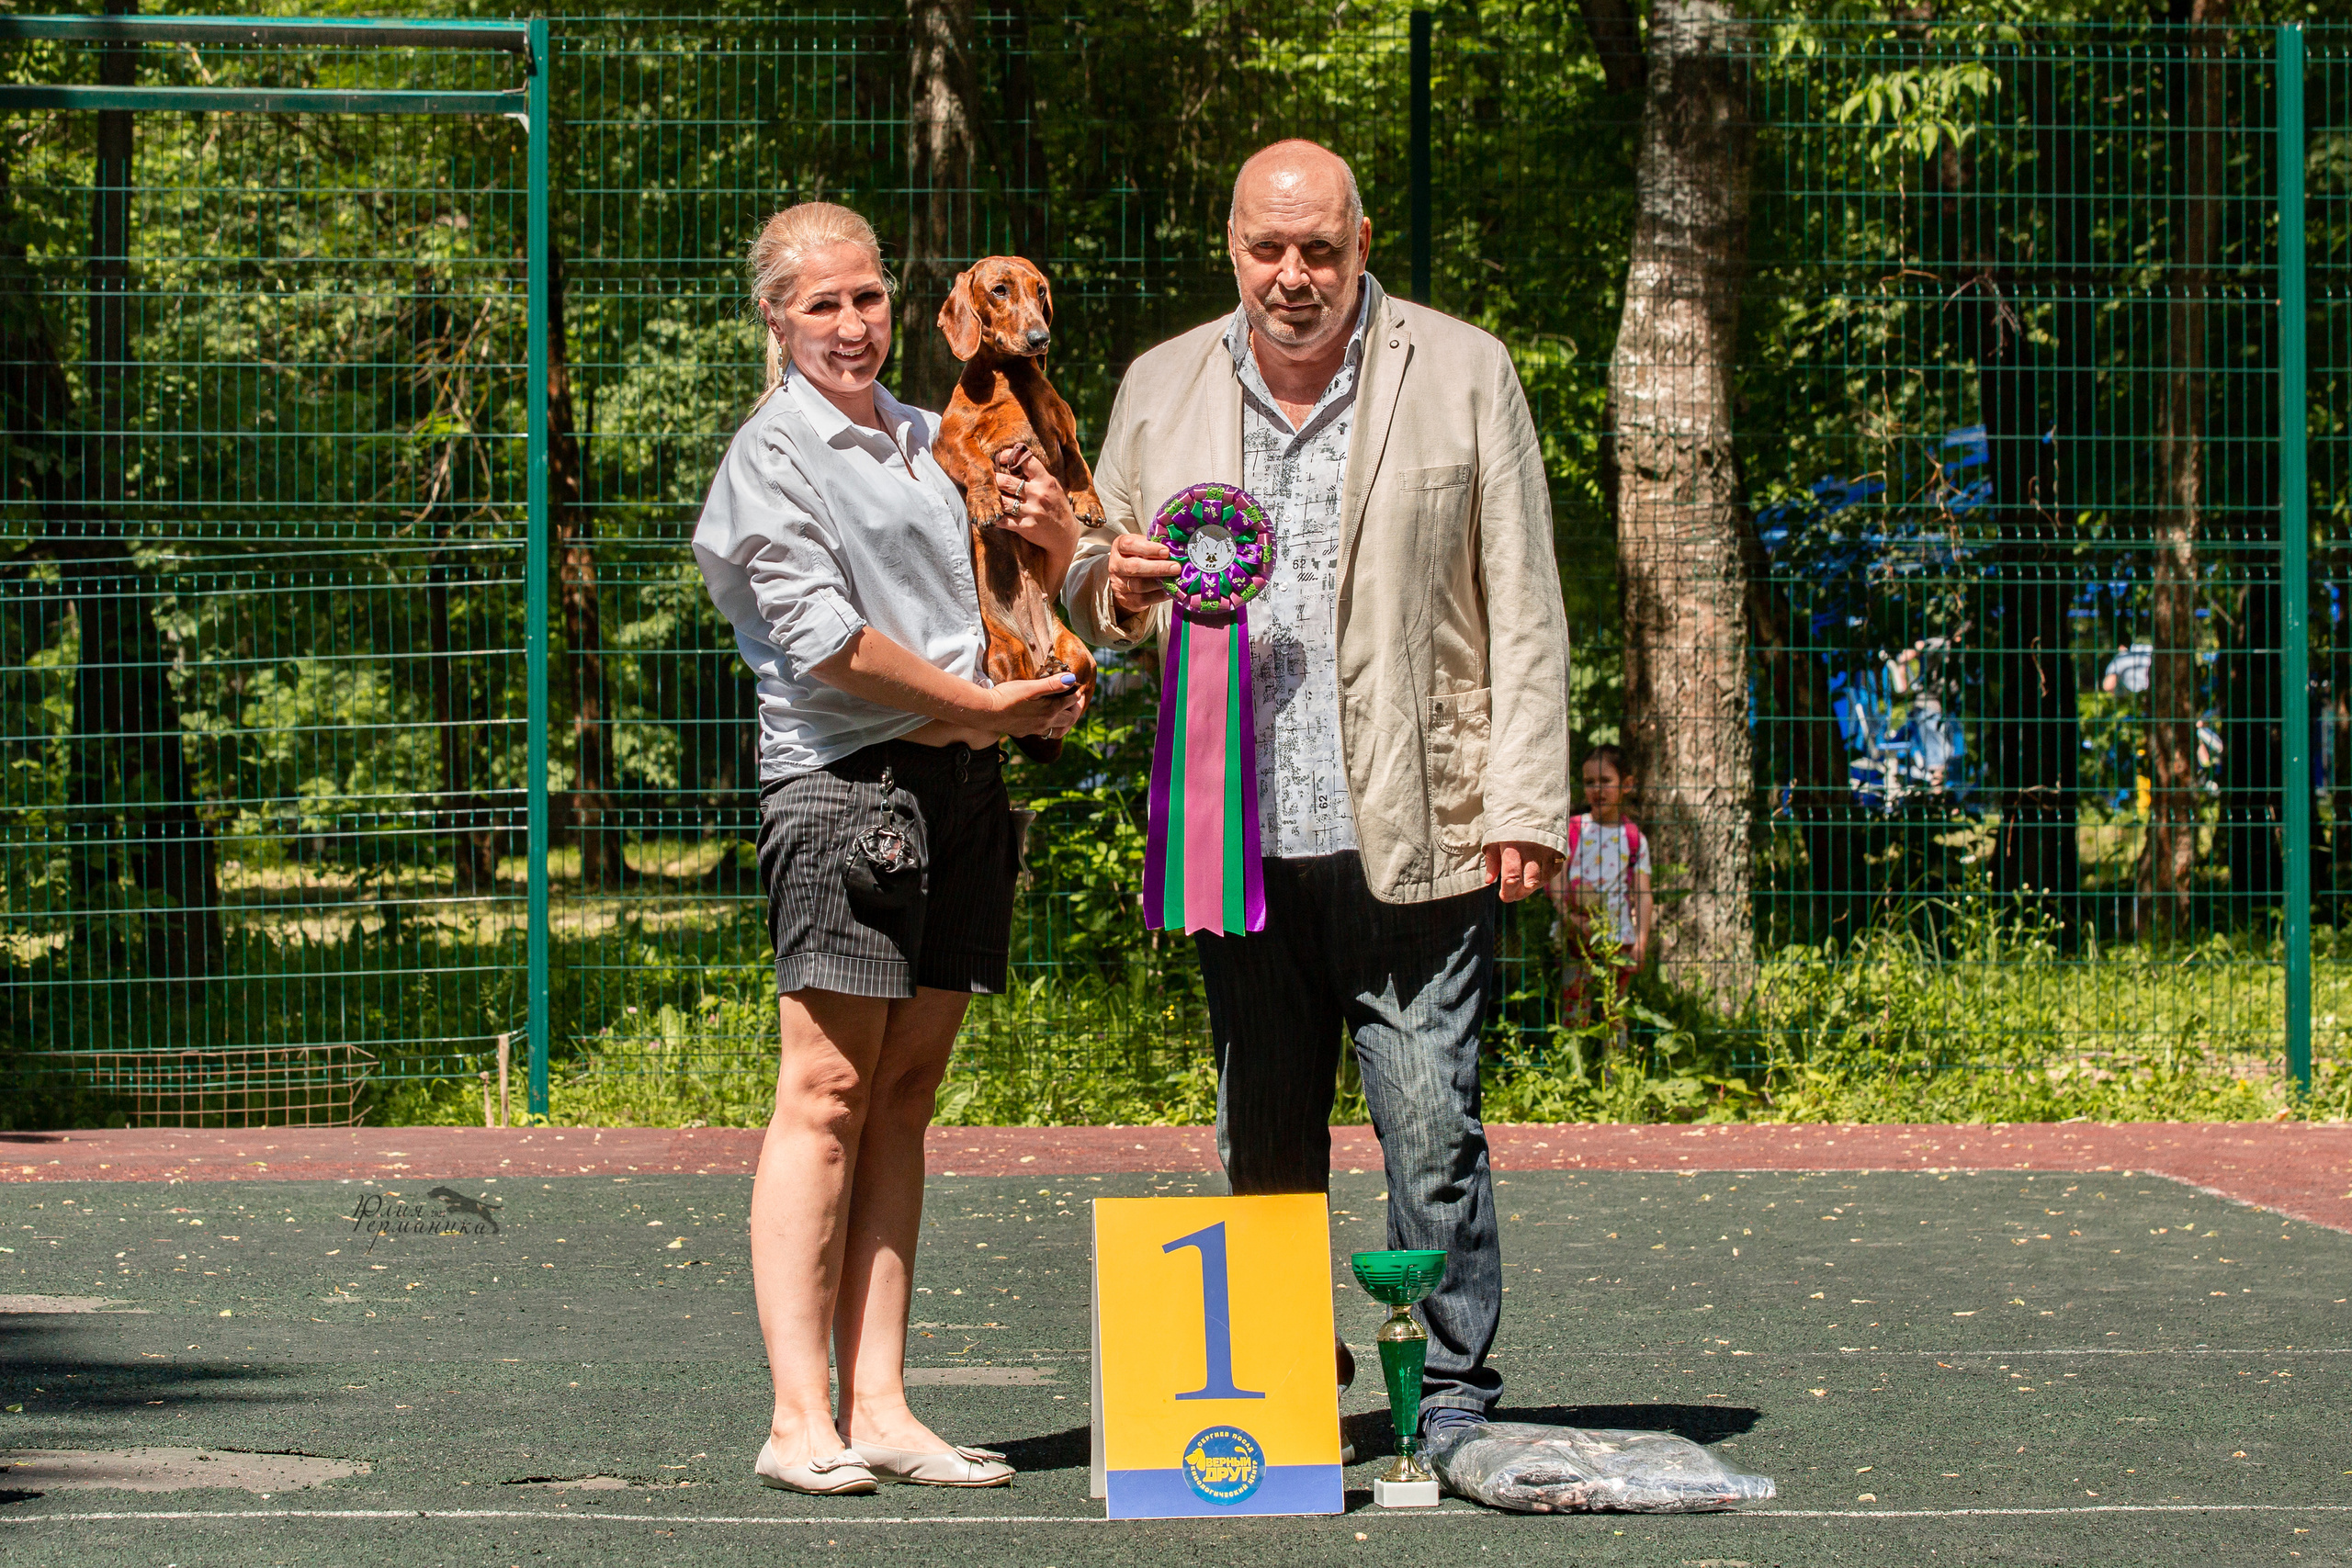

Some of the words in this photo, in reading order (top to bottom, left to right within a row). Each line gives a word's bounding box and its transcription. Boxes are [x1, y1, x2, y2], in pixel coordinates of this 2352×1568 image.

[1292, 558, 1306, 570] 62
[1318, 795, 1329, 809] 62
[1161, 1221, 1266, 1401] 1
[1196, 1431, 1230, 1448] СЕРГИЕВ
[1231, 1433, 1254, 1453] ПОСАД
[1190, 1465, 1250, 1498] КИНОЛОГИЧЕСКИЙ
[1247, 1460, 1258, 1484] ЦЕНТР
[1202, 1466, 1252, 1483] ДРУГ
